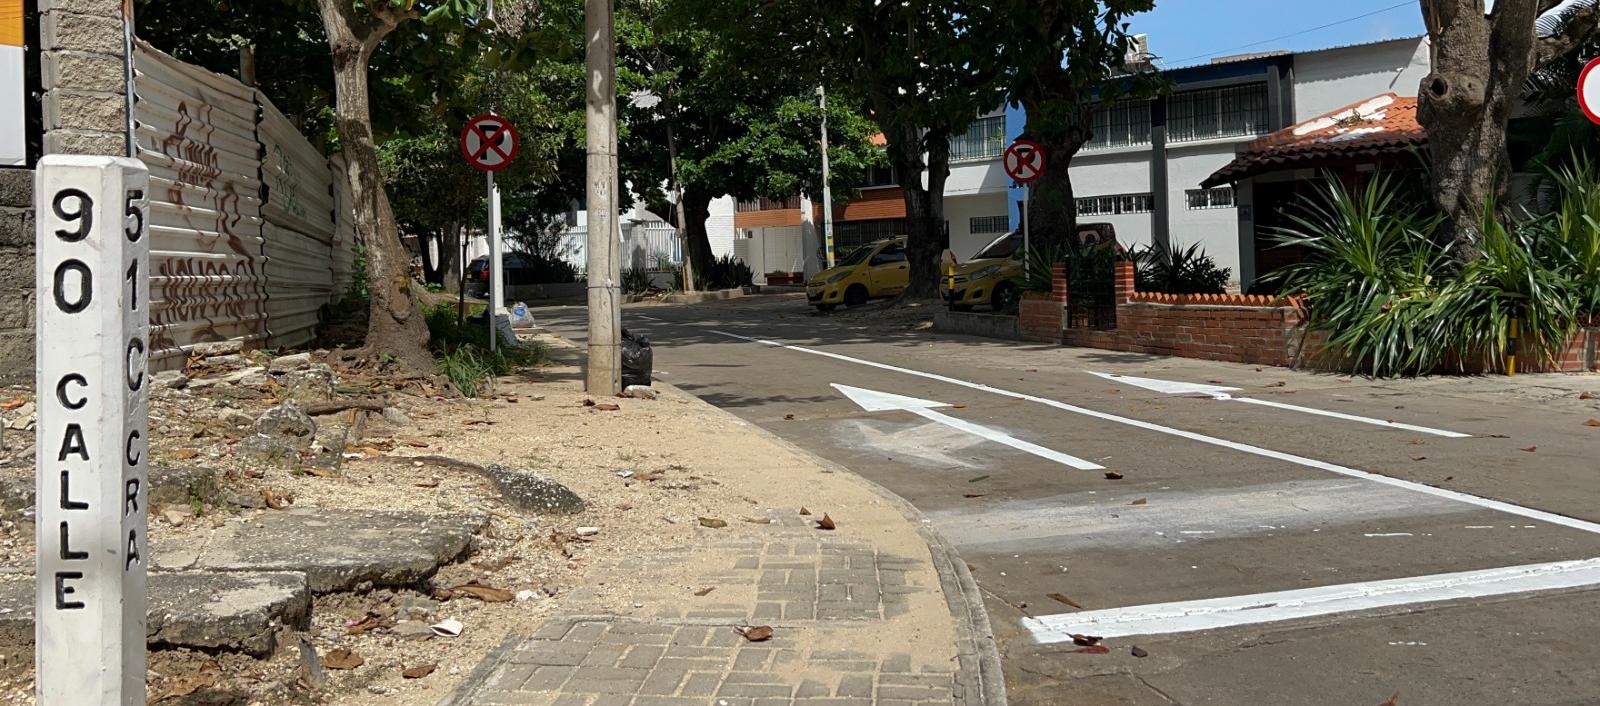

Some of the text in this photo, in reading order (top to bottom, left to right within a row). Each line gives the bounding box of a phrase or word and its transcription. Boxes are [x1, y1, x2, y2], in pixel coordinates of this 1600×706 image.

[52, 187, 94, 610] 90 CALLE
[125, 429, 141, 572] CRA
